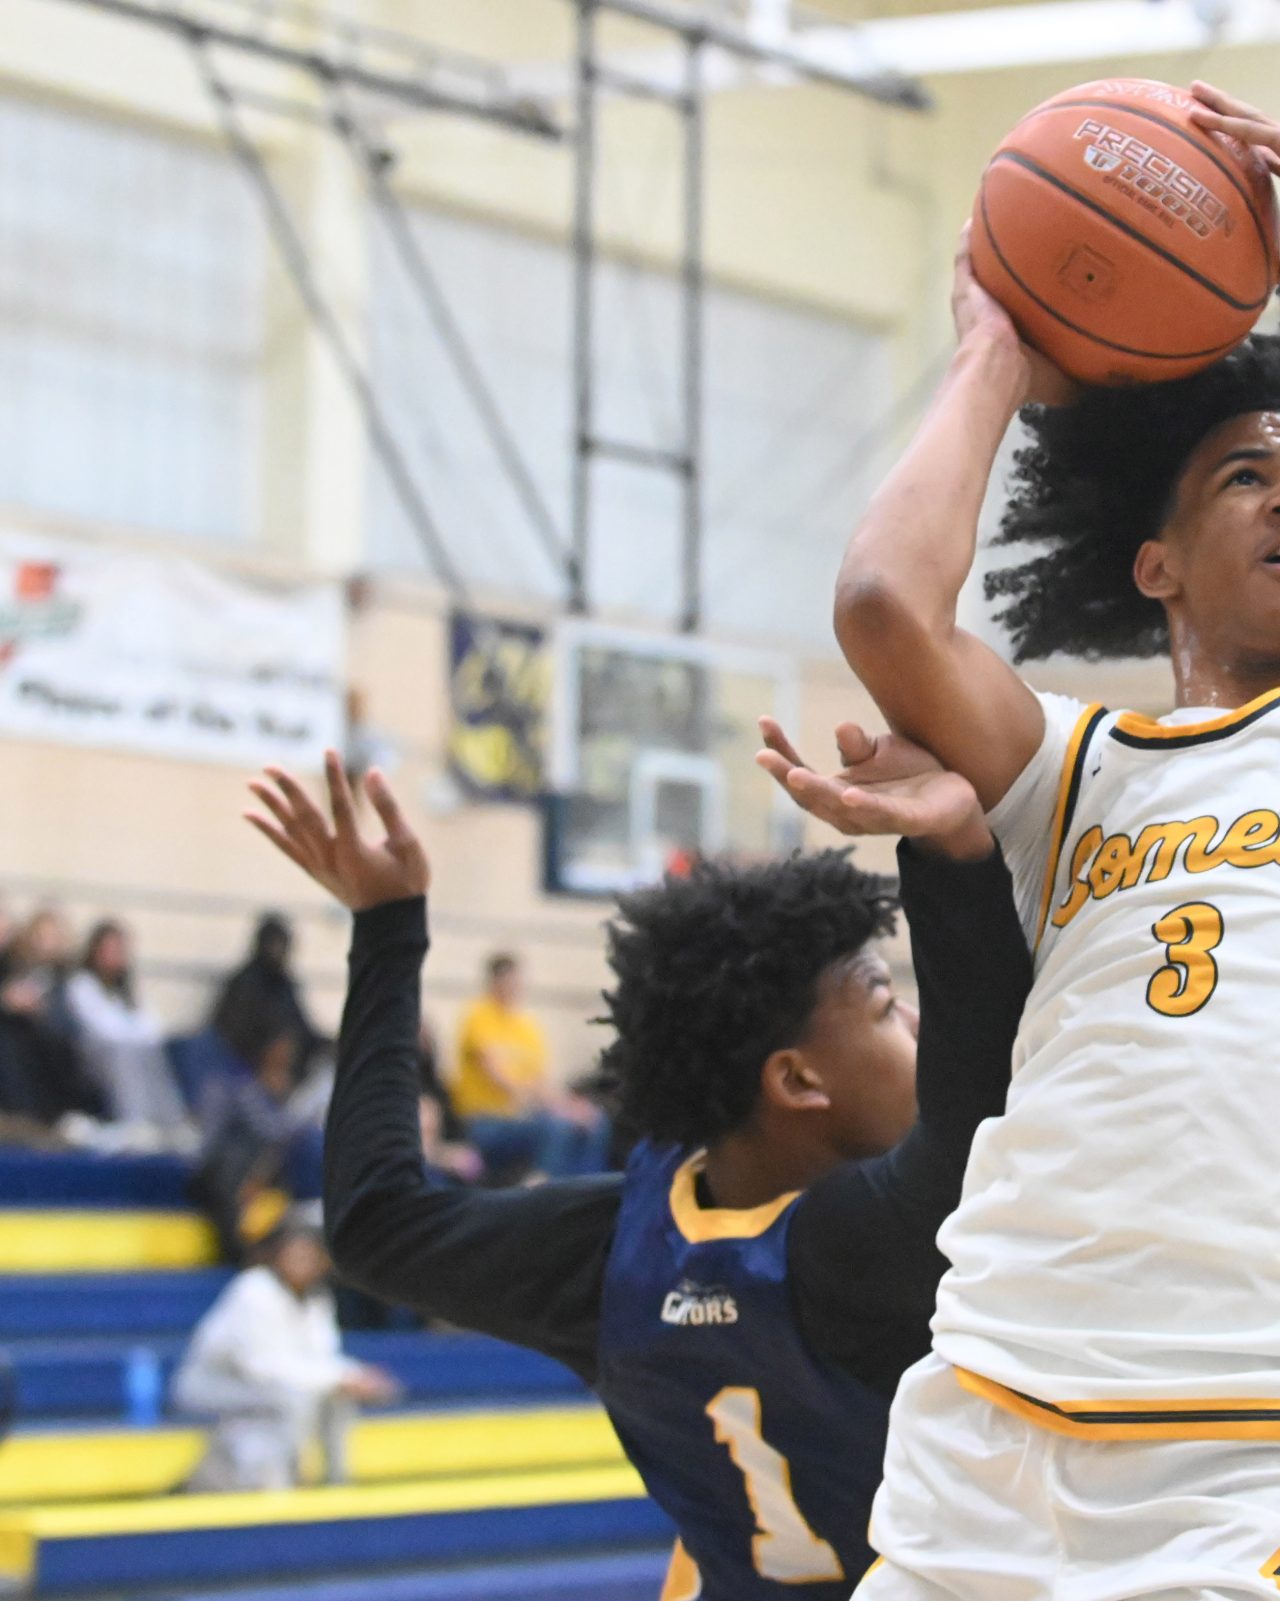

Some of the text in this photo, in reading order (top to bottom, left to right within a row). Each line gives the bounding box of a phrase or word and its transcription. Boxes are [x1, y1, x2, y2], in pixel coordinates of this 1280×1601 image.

[1072, 118, 1236, 239] PRECISION
[1119, 164, 1213, 239] 1000
[1146, 901, 1224, 1017] 3
[705, 1385, 846, 1584] 1
